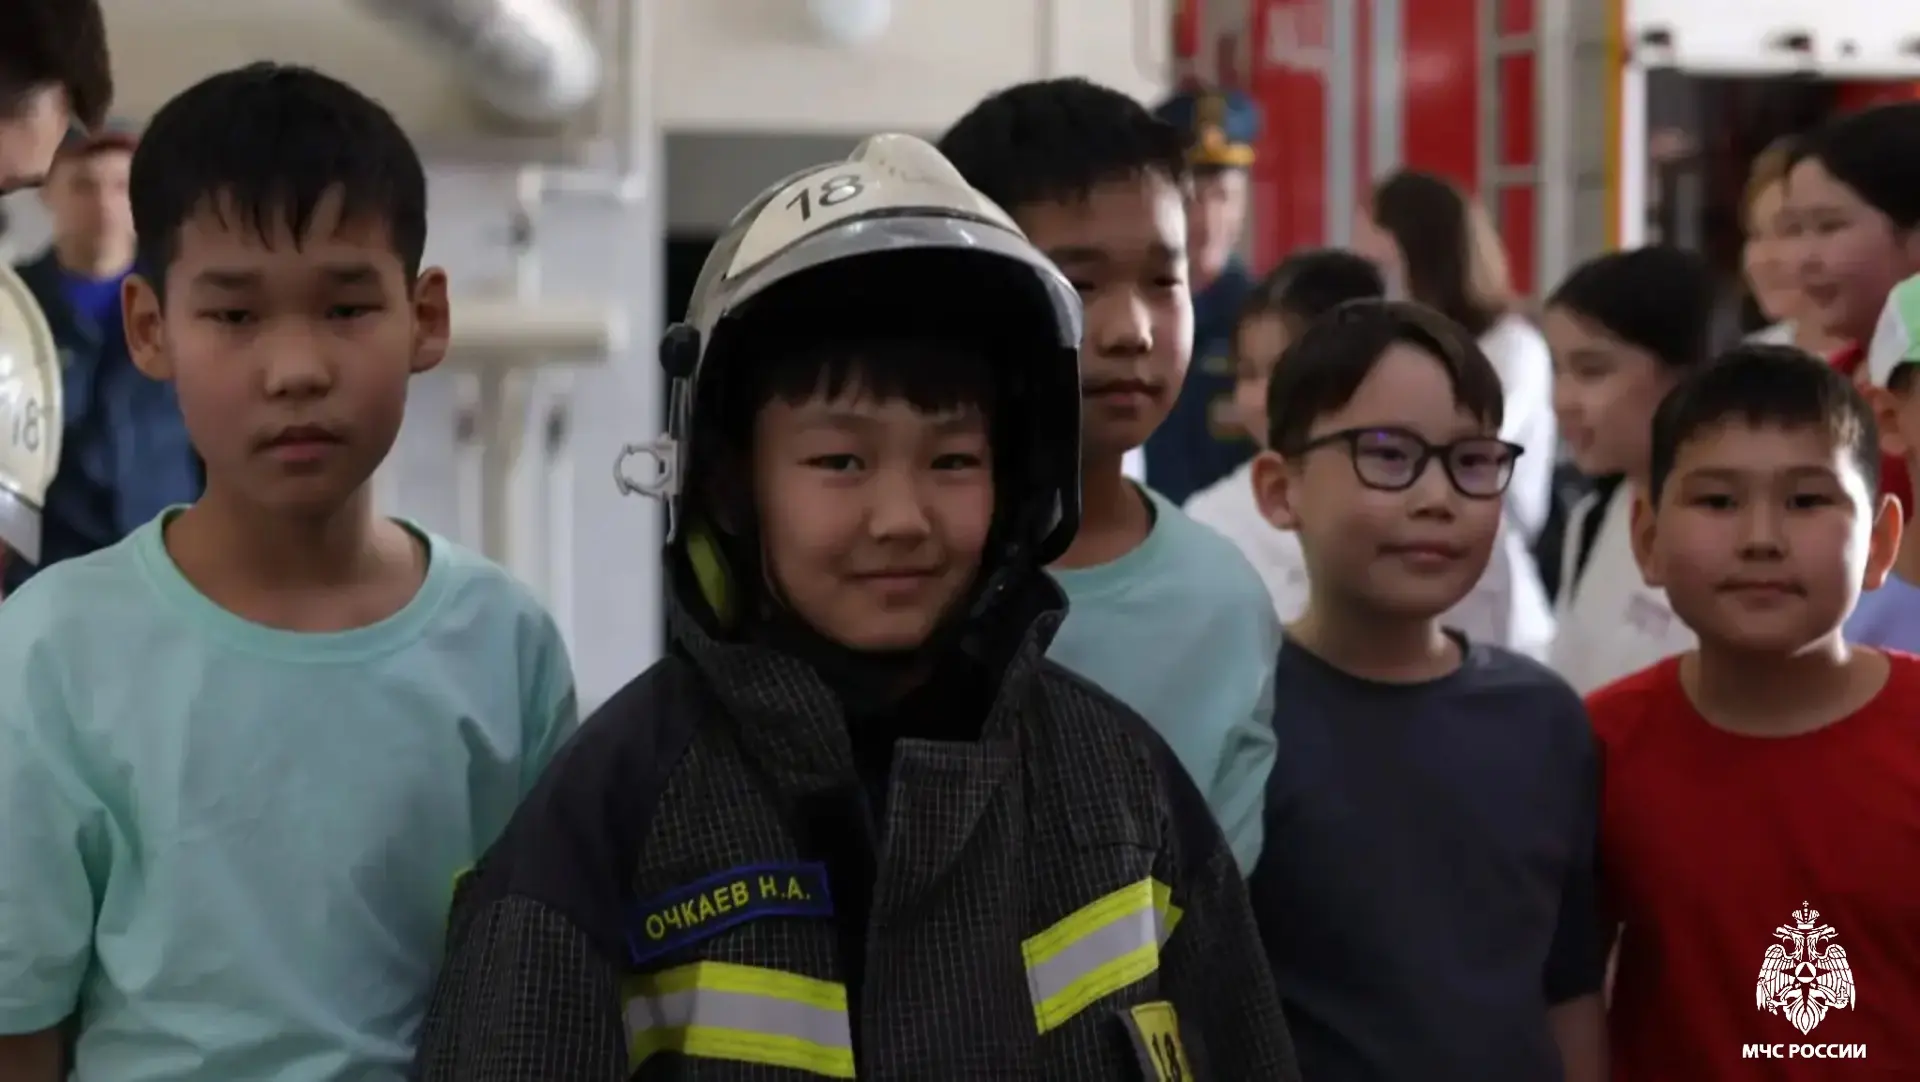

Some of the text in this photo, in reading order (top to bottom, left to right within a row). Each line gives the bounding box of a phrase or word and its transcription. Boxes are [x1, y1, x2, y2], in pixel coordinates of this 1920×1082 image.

[786, 174, 864, 221] 18
[12, 397, 40, 453] 18
[645, 875, 811, 939] ОЧКАЕВ Н.А.
[1151, 1031, 1183, 1082] 18
